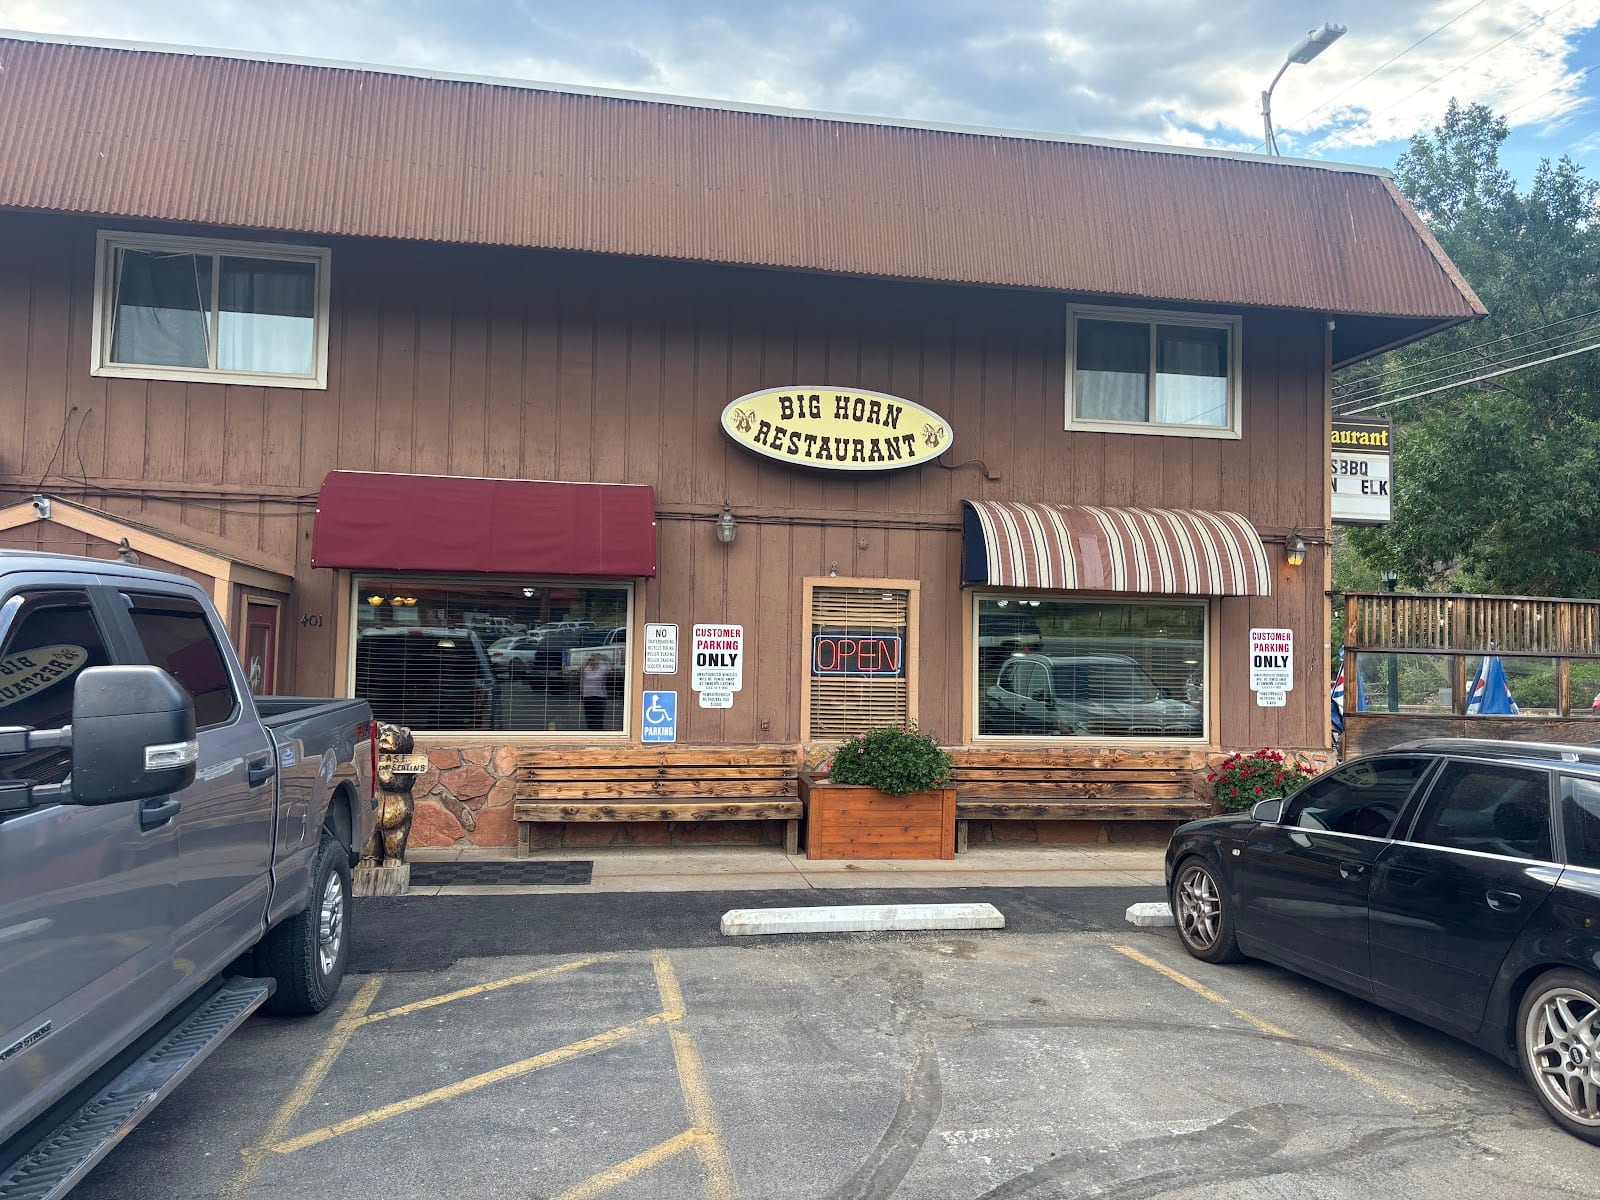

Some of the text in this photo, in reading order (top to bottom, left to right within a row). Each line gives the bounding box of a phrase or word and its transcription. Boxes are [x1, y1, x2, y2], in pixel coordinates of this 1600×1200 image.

[778, 394, 903, 430] BIG HORN
[753, 419, 917, 463] RESTAURANT
[1331, 429, 1389, 446] aurant
[1361, 479, 1388, 496] ELK
[301, 613, 323, 628] 401
[655, 628, 667, 638] NO
[695, 628, 741, 638] CUSTOMER
[1252, 632, 1291, 641] CUSTOMER
[697, 640, 739, 651] PARKING
[1253, 643, 1289, 653] PARKING
[696, 652, 738, 667] ONLY
[817, 639, 898, 671] OPEN
[1254, 655, 1289, 668] ONLY
[644, 726, 674, 737] PARKING
